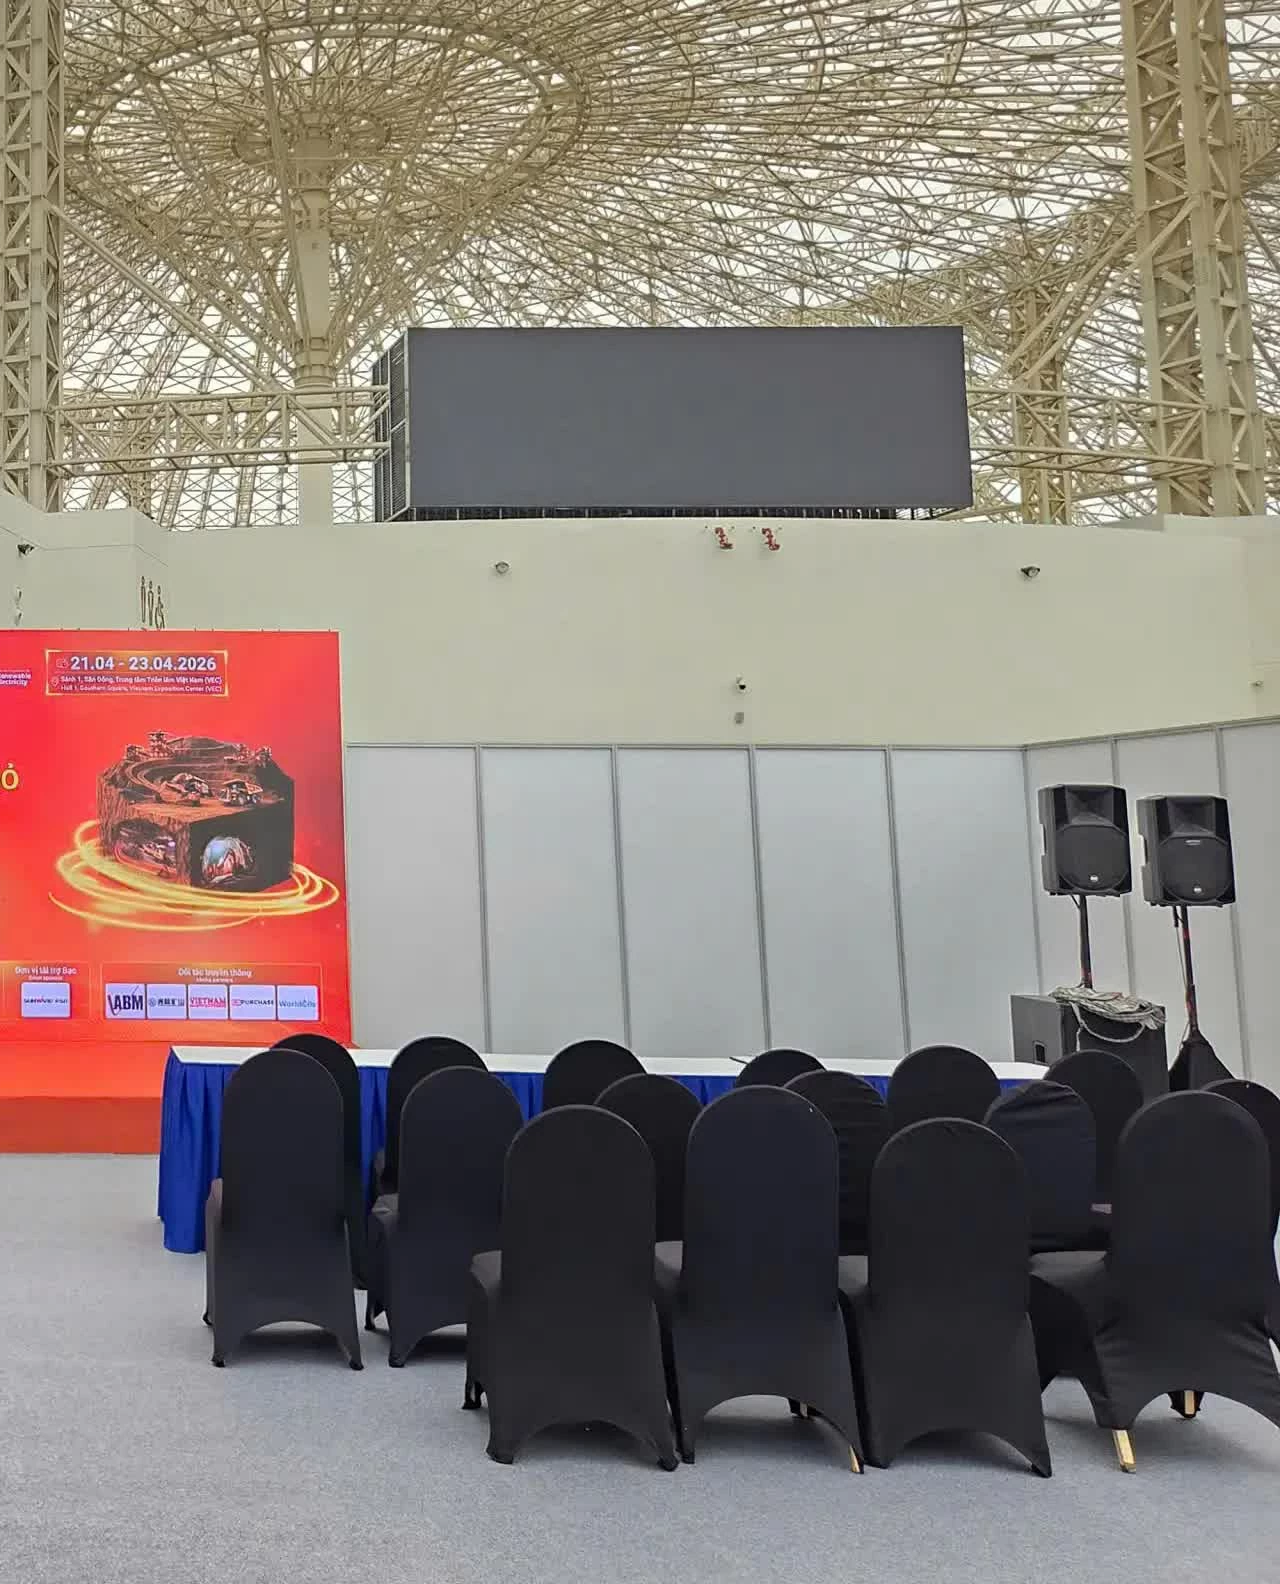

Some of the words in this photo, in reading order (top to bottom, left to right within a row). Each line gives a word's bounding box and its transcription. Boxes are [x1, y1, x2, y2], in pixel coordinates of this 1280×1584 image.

[70, 656, 114, 671] 21.04
[128, 656, 217, 671] 23.04.2026
[108, 993, 144, 1013] ABM
